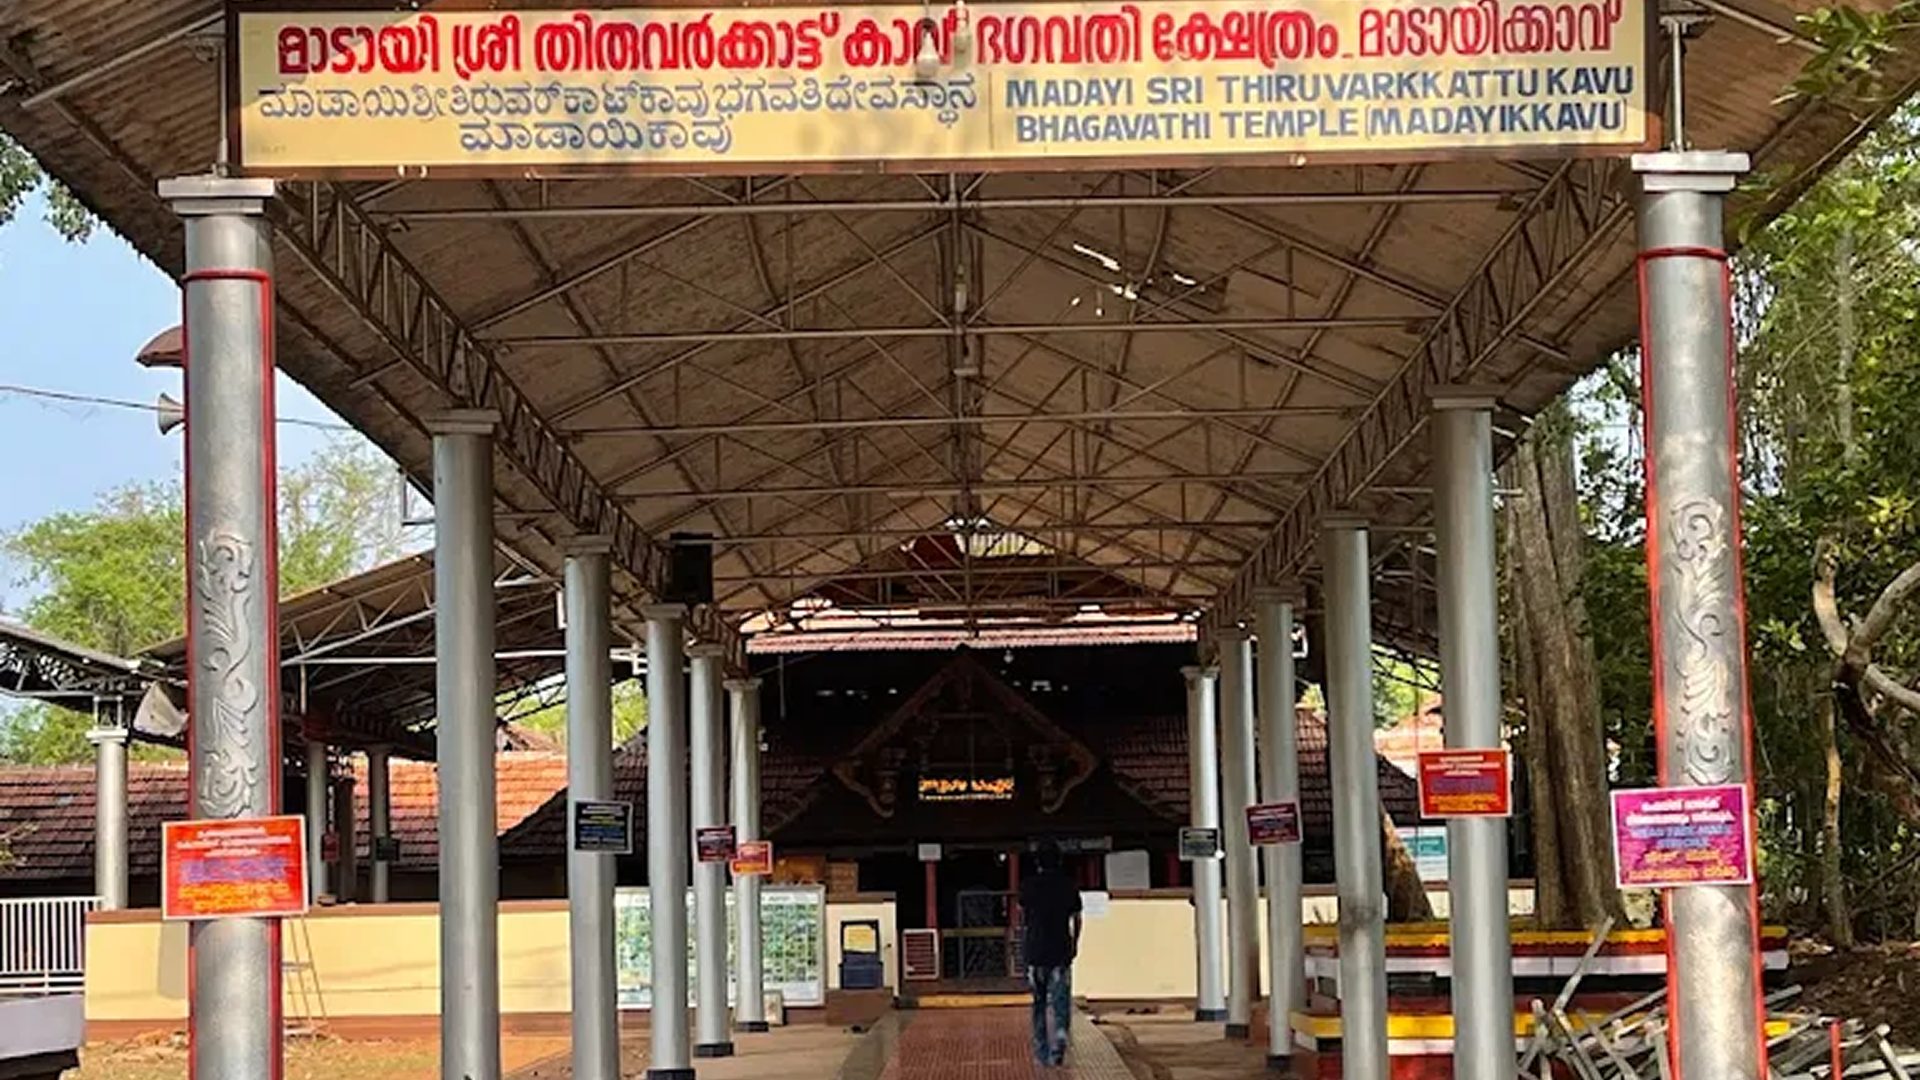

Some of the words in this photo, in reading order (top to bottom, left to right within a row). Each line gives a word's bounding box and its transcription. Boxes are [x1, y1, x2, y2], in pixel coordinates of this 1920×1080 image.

[278, 15, 440, 74] മാടായി
[453, 14, 520, 80] ശ്രീ
[1005, 78, 1133, 108] MADAYI
[1147, 77, 1203, 105] SRI
[1016, 112, 1211, 143] BHAGAVATHI
[1220, 108, 1359, 139] TEMPLE
